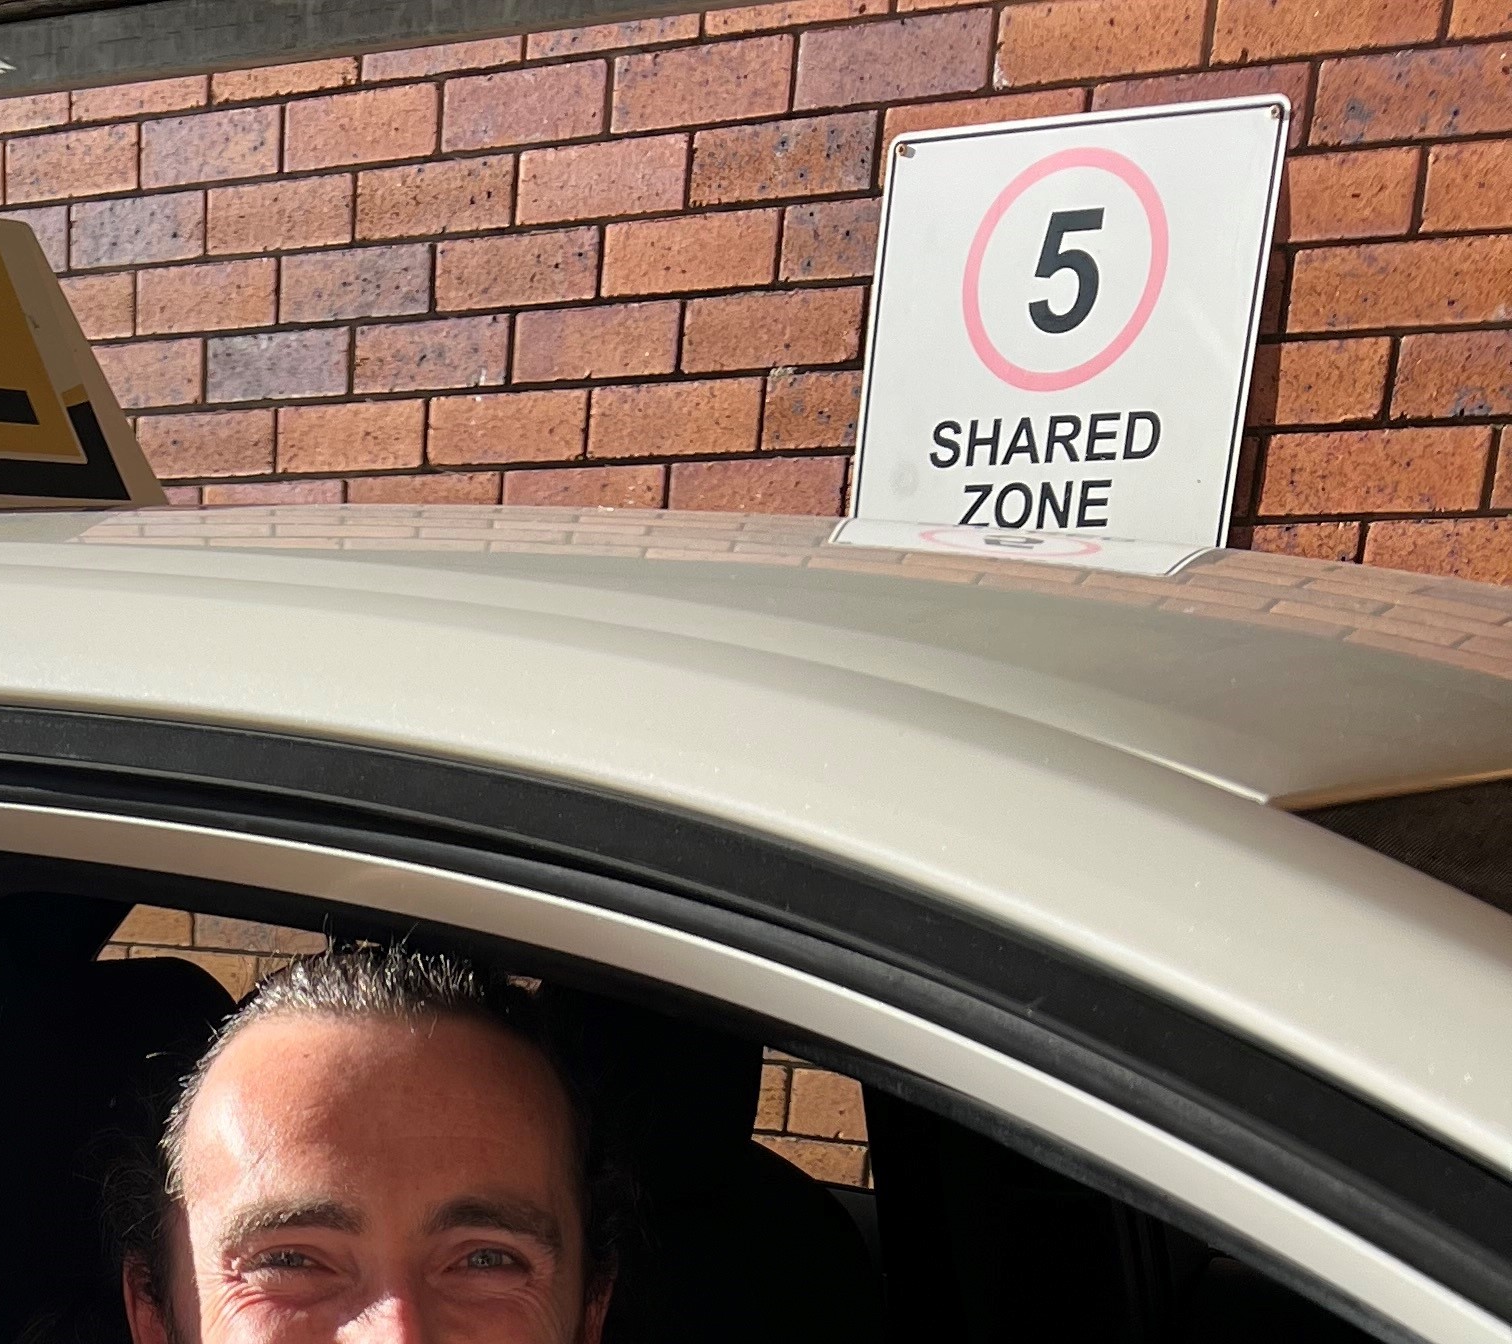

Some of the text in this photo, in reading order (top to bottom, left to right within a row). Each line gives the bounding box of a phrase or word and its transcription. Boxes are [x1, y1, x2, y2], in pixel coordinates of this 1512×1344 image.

[1028, 207, 1105, 334] 5
[928, 410, 1162, 469] SHARED
[958, 478, 1113, 530] ZONE
